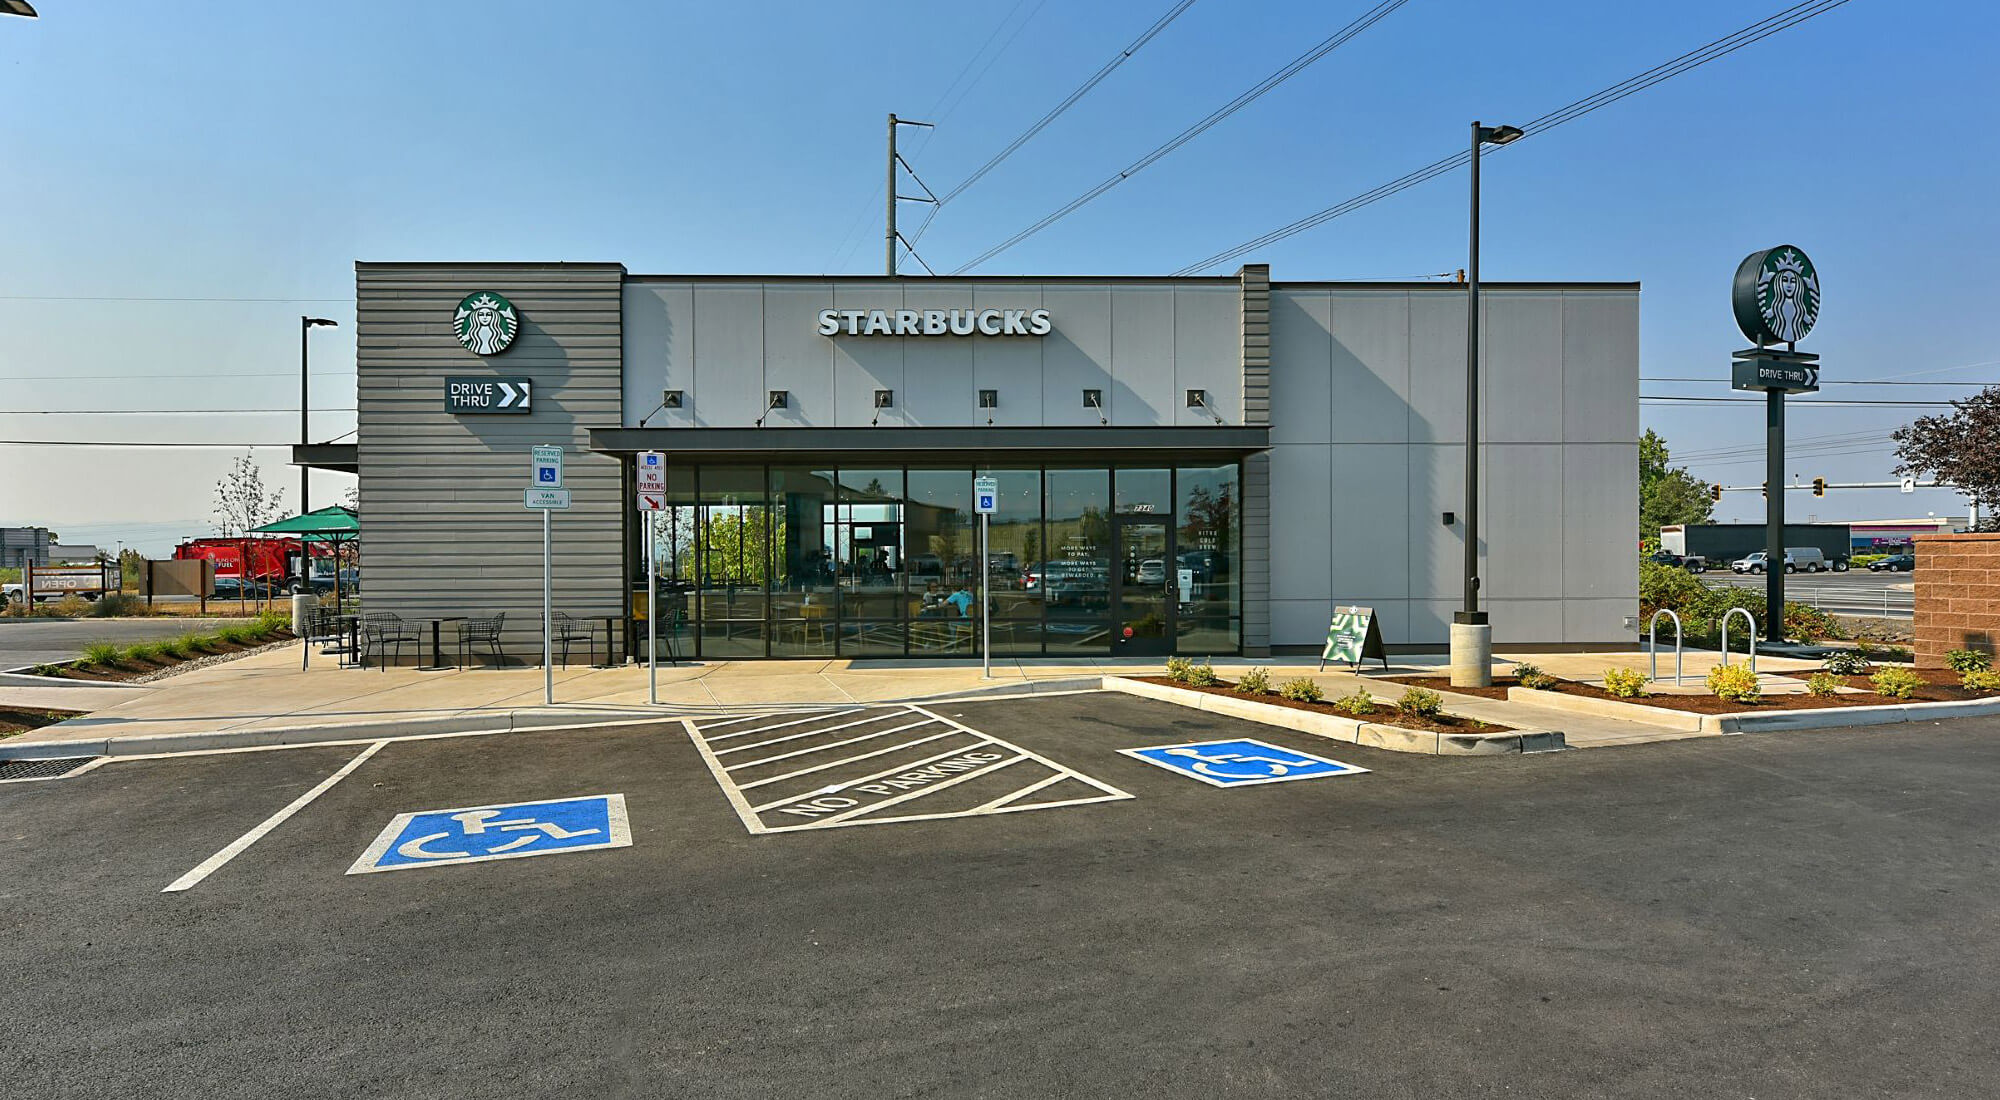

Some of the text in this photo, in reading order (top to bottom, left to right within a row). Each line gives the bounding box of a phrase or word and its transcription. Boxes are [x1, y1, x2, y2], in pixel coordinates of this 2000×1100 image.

[818, 308, 1051, 336] STARBUCKS
[1760, 368, 1804, 381] DRIVE THRU
[450, 383, 493, 395] DRIVE
[450, 395, 490, 407] THRU
[646, 473, 657, 482] NO
[639, 482, 665, 491] PARKING
[778, 752, 1003, 817] NO PARKING
